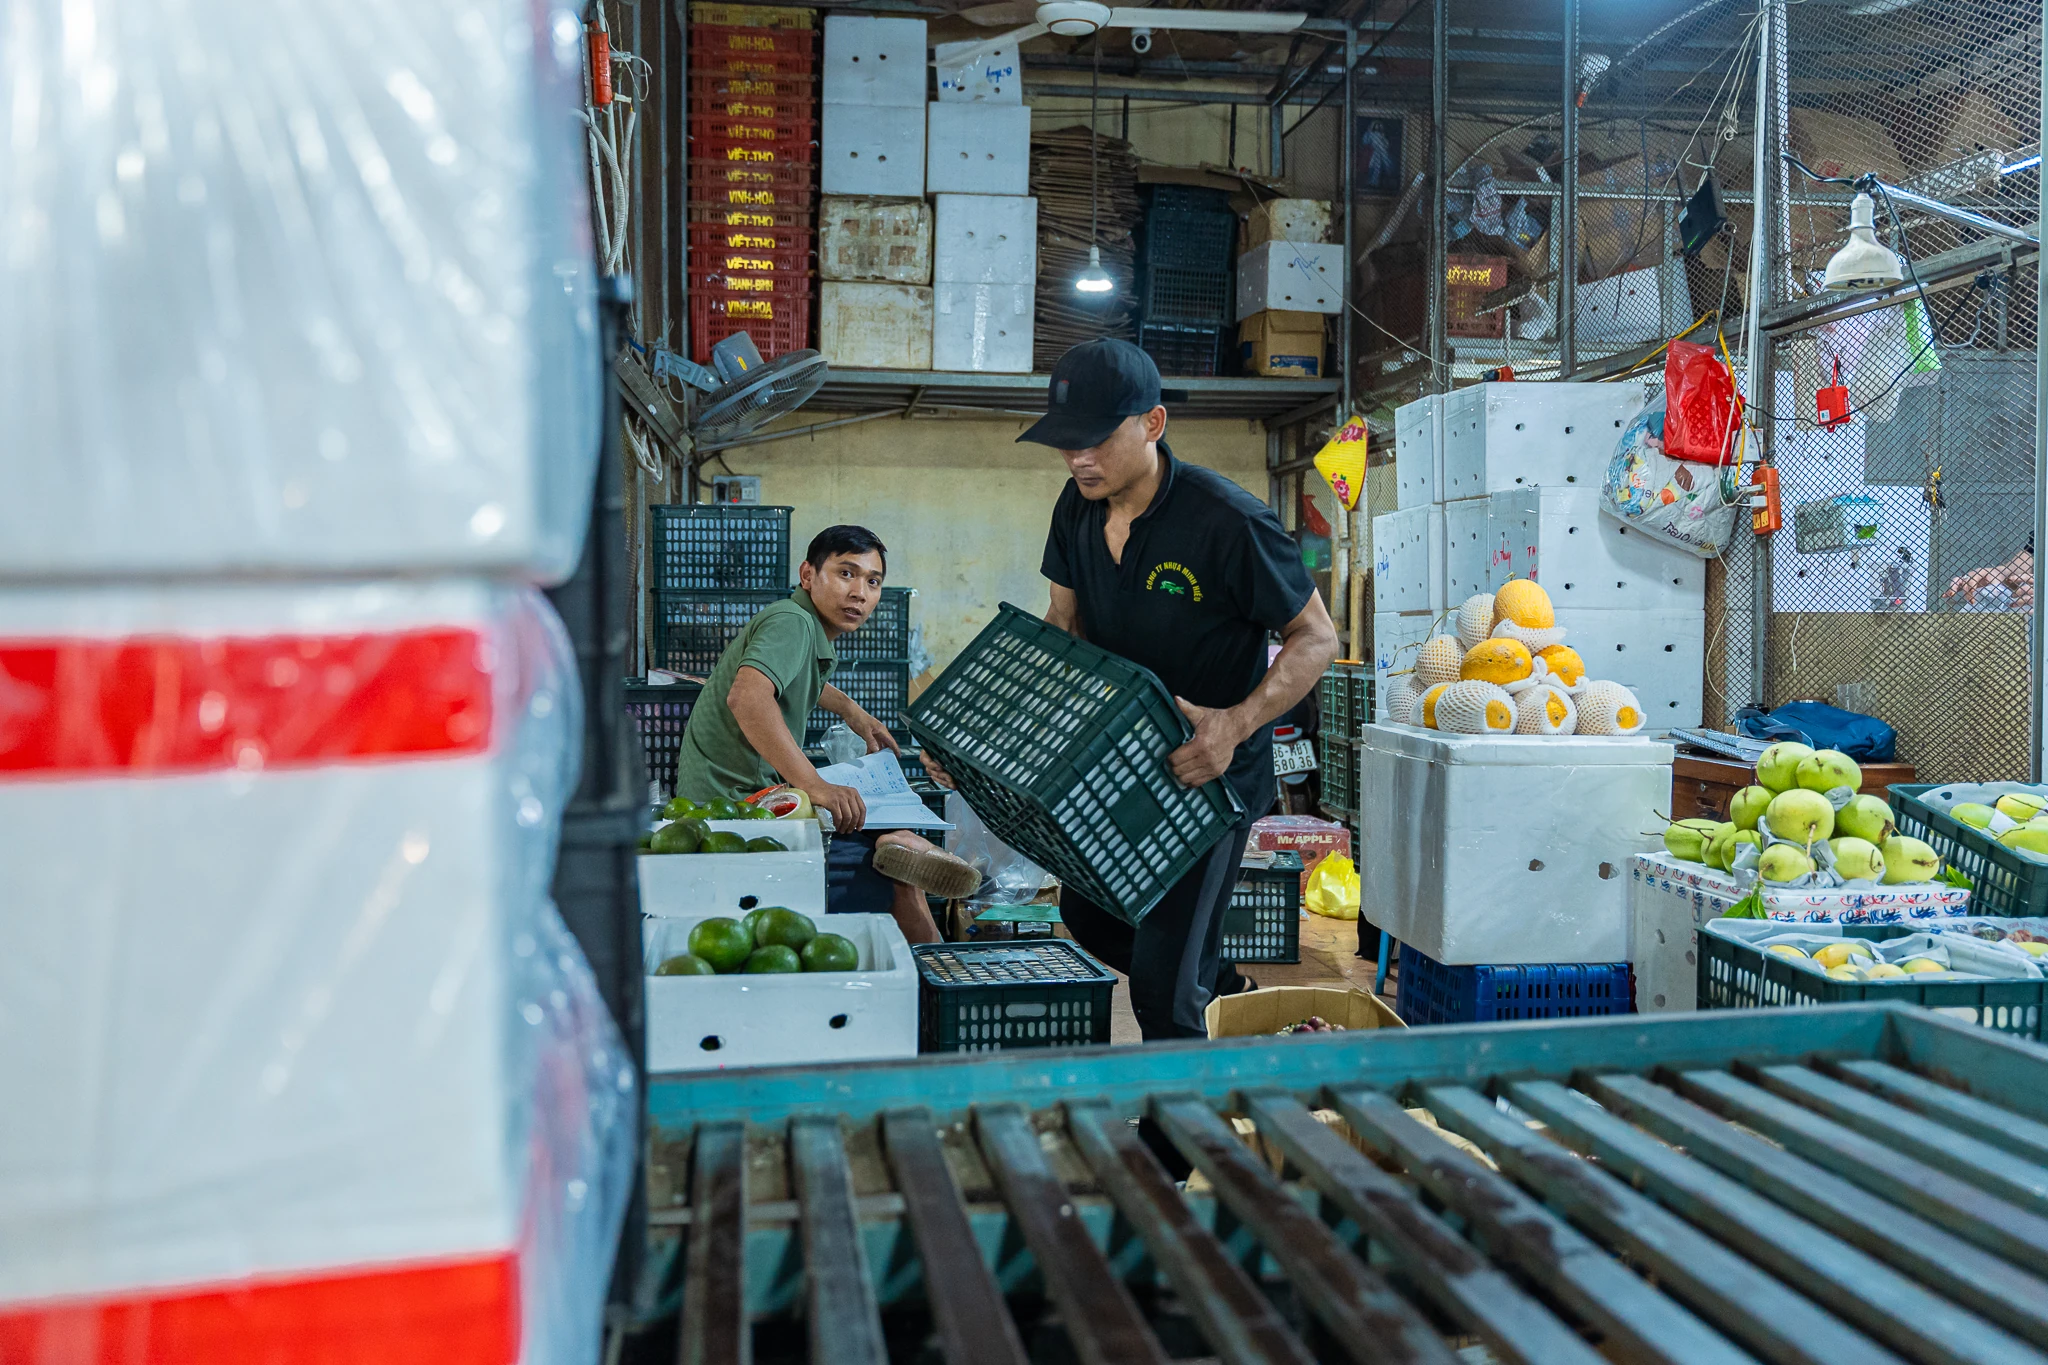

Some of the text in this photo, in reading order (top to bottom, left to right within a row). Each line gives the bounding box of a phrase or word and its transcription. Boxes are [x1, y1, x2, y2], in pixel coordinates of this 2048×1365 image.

[1155, 563, 1163, 573] TY
[1181, 567, 1198, 586] MINH
[1274, 756, 1313, 772] 580.36
